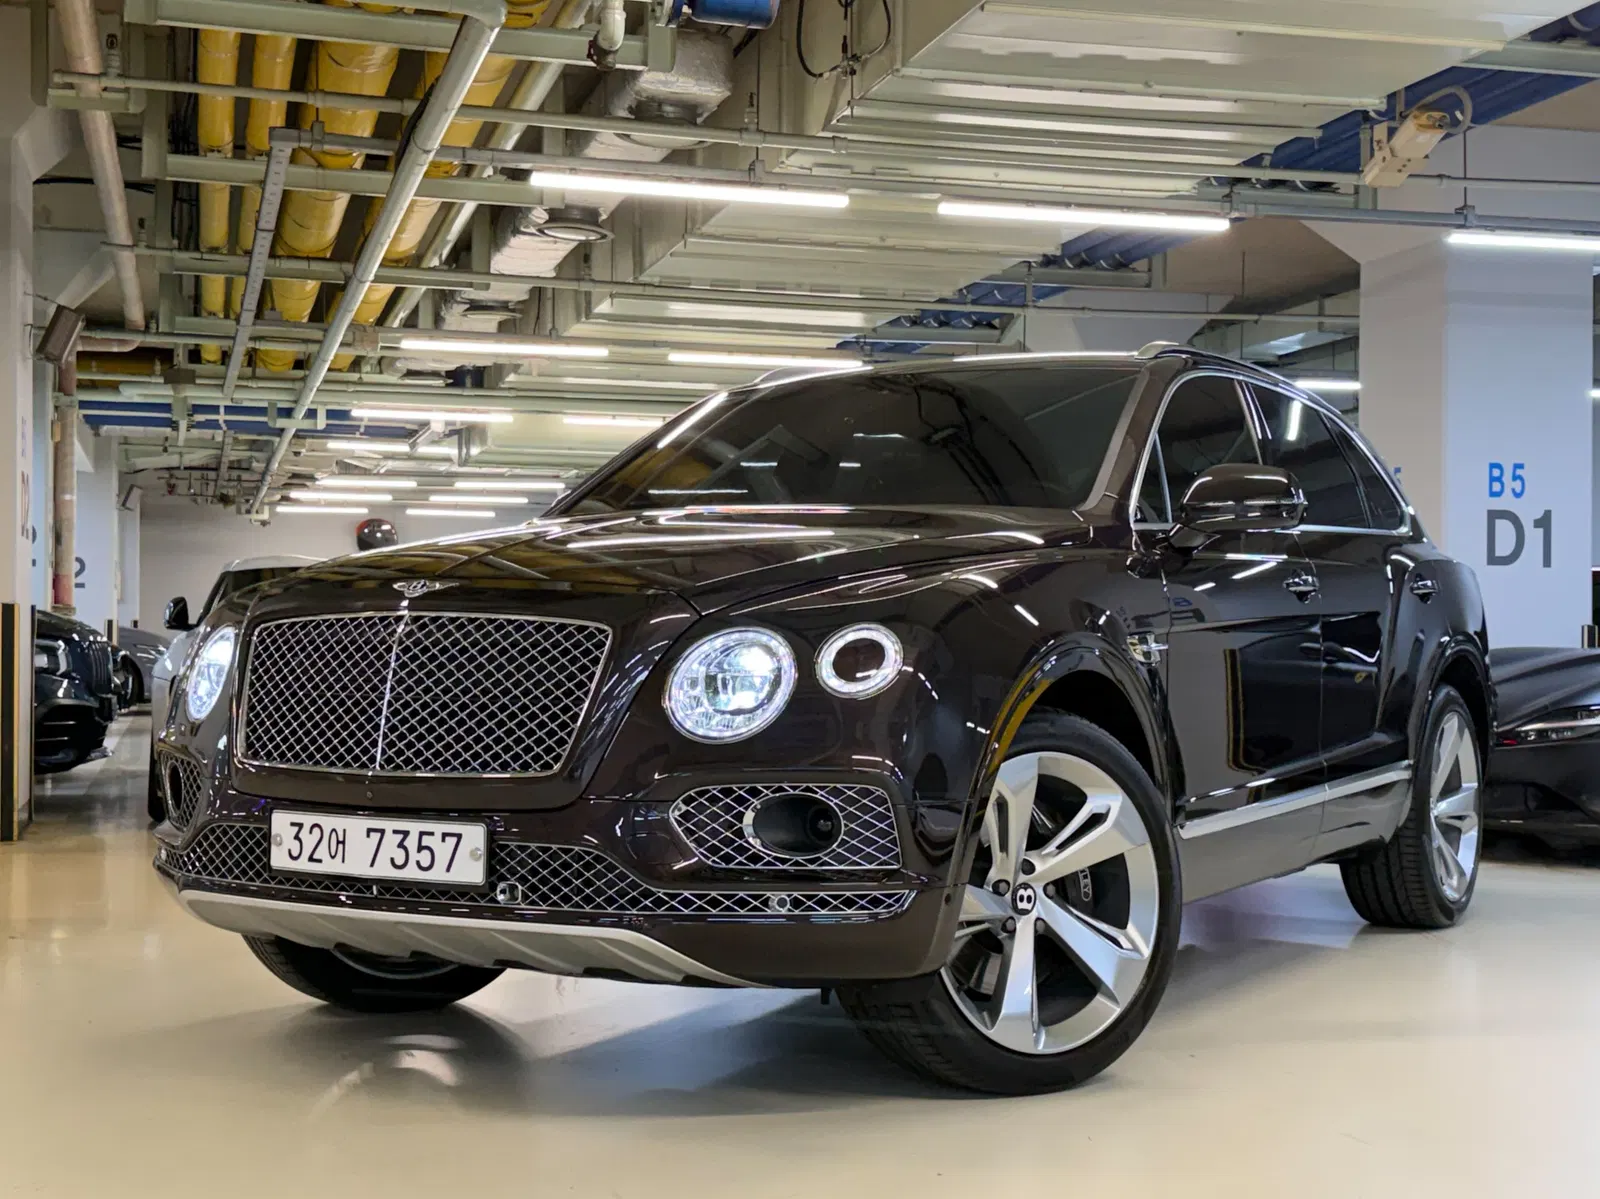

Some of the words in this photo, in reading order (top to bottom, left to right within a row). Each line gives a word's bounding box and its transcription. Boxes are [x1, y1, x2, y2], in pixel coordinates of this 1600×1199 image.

[1488, 462, 1526, 499] B5
[1486, 509, 1552, 568] D1
[287, 821, 346, 864] 32어
[366, 827, 463, 873] 7357
